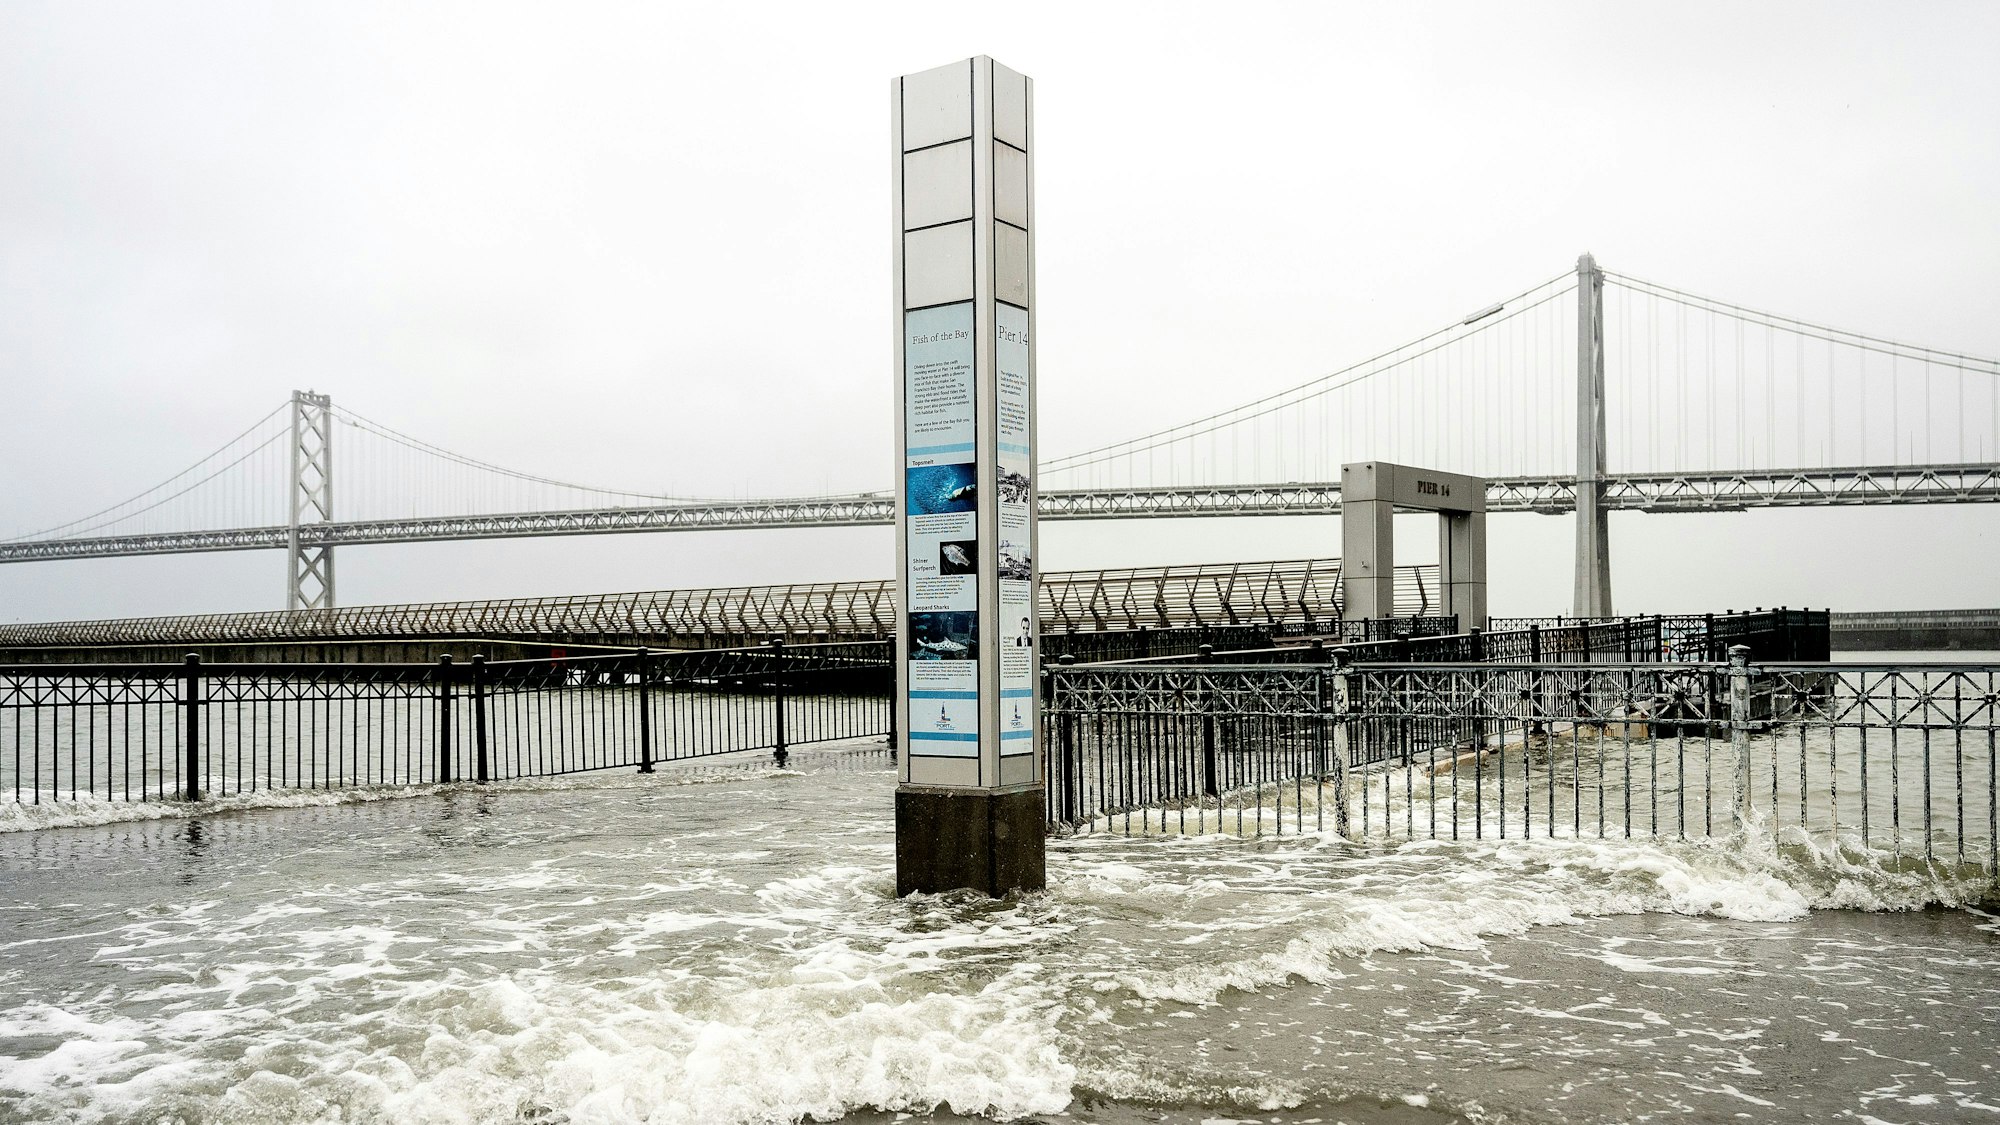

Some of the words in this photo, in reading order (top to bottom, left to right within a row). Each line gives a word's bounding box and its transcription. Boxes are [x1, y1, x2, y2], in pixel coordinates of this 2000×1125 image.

[912, 334, 928, 344] Fish
[931, 333, 939, 342] of
[941, 332, 952, 340] the
[955, 330, 969, 339] Bay
[998, 325, 1016, 342] Pier
[1019, 331, 1028, 345] 14
[1417, 480, 1438, 495] PIER
[1441, 484, 1450, 496] 14
